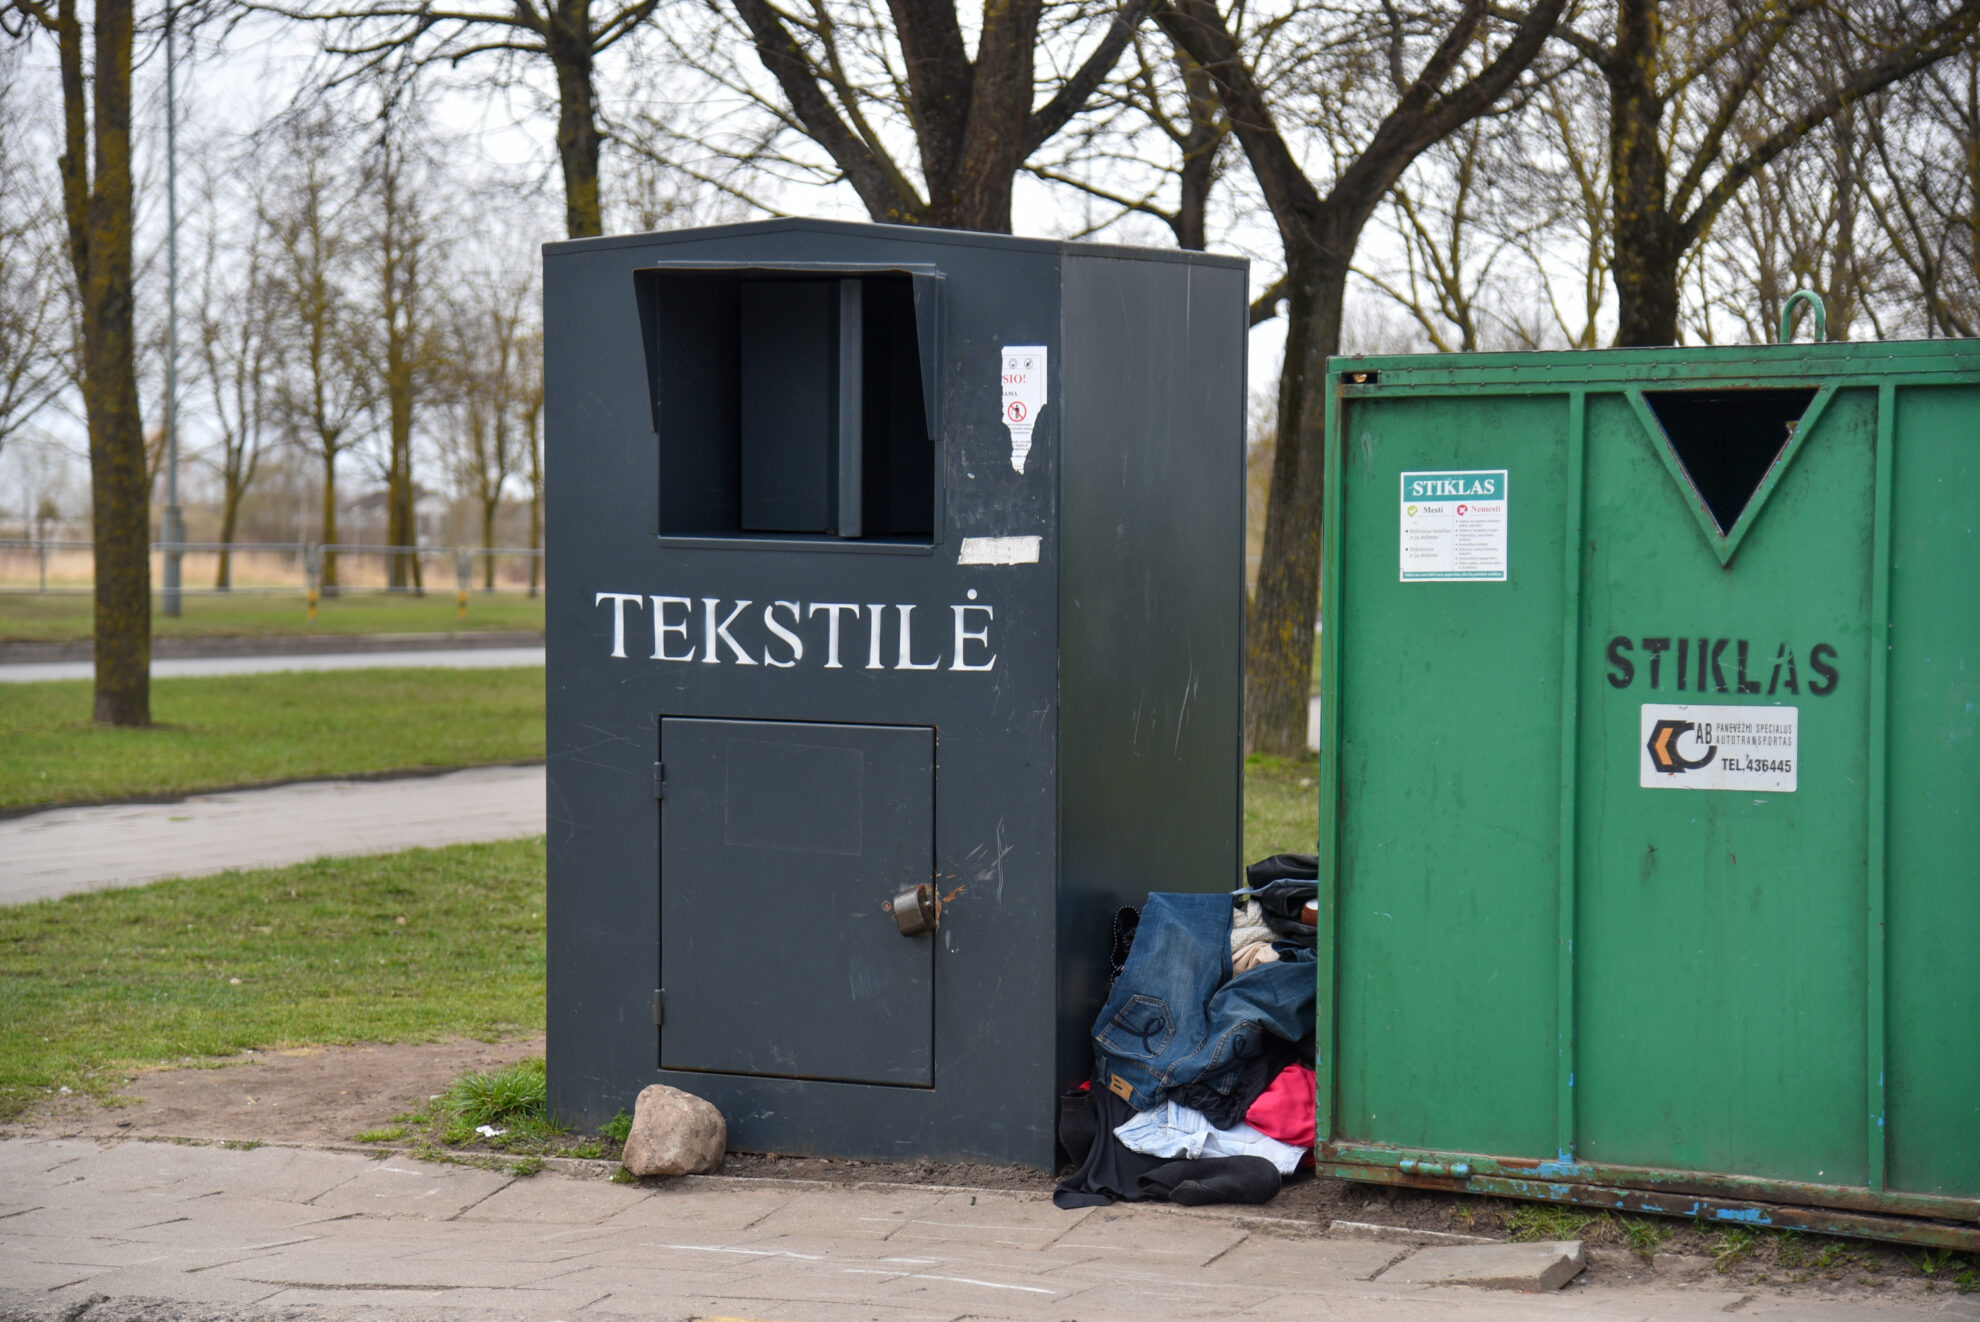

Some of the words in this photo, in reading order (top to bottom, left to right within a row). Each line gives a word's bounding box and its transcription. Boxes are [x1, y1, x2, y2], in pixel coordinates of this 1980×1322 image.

[1413, 479, 1495, 496] STIKLAS
[1423, 505, 1444, 513] Mesti
[1471, 505, 1501, 513] Nemesti
[595, 588, 997, 671] TEKSTILĖ
[1606, 635, 1840, 697] STIKLAS
[1696, 723, 1713, 744] AB
[1756, 723, 1792, 734] SPECIALUS
[1716, 735, 1792, 746] AUTOTRANSPORTAS
